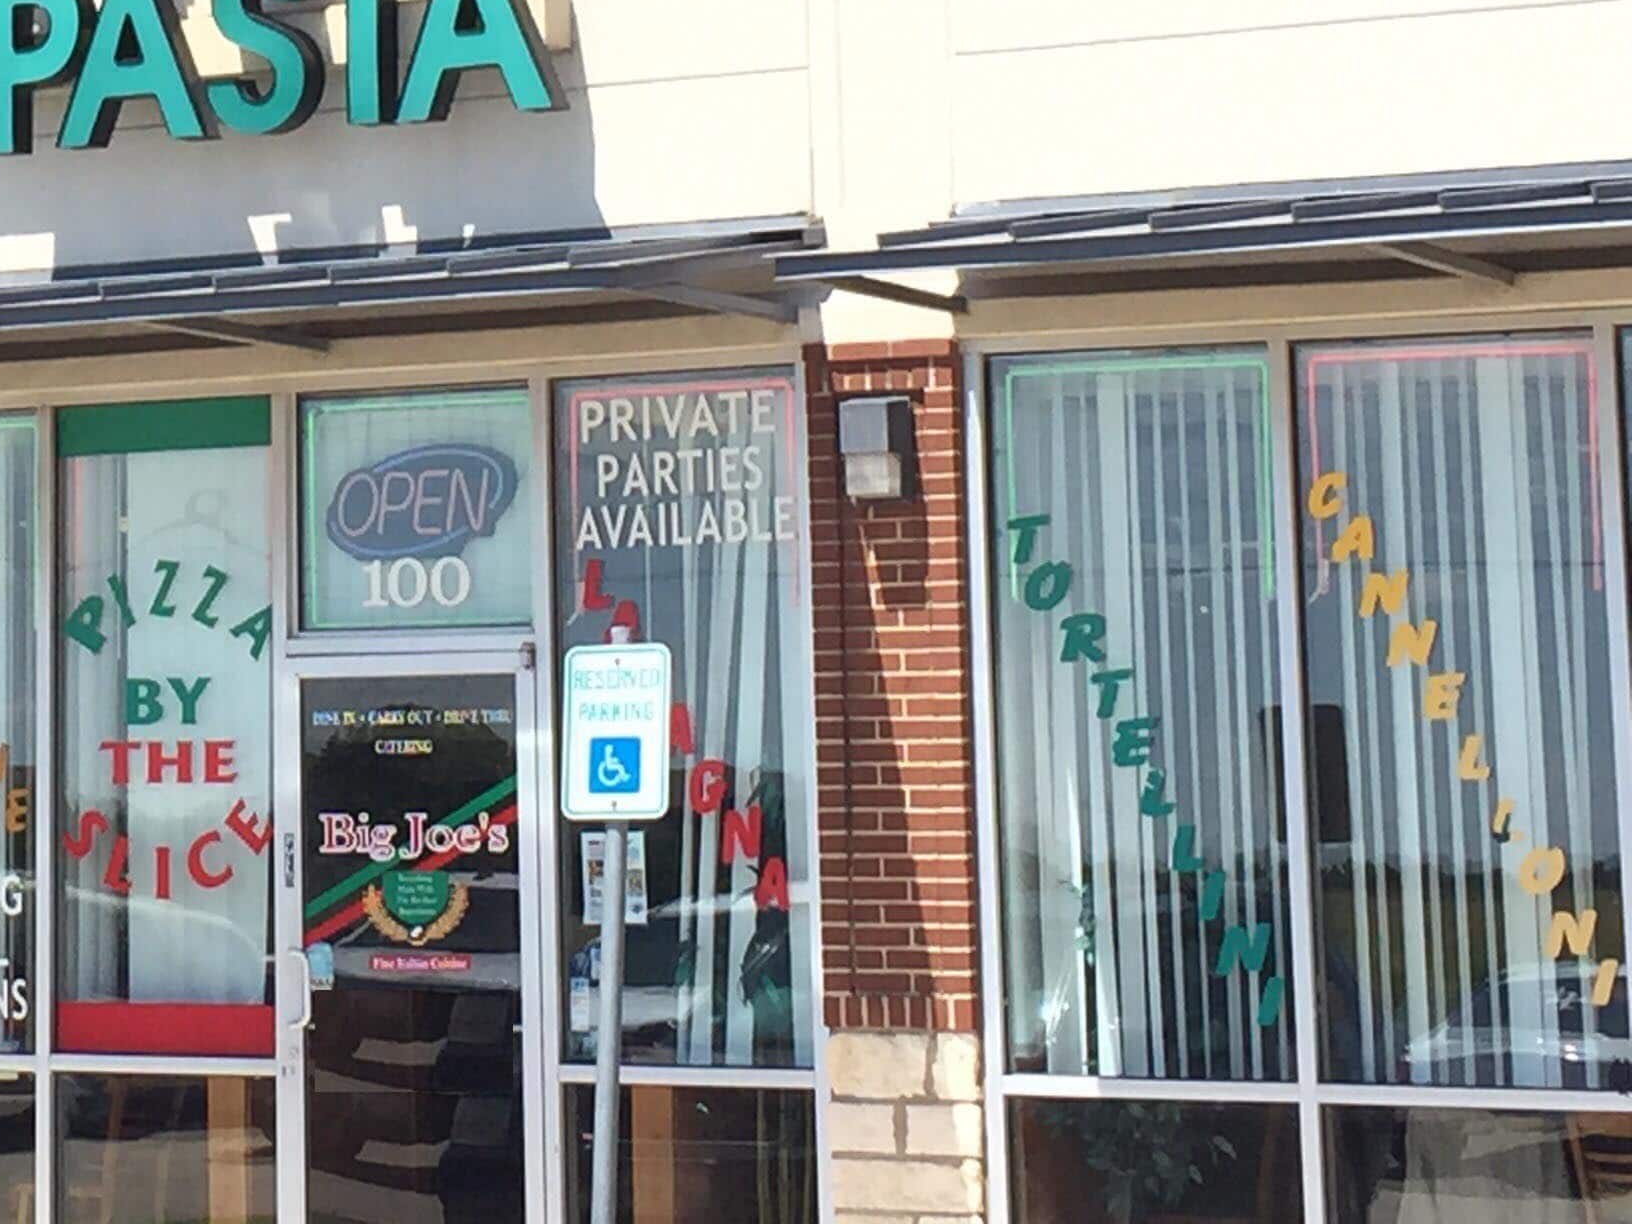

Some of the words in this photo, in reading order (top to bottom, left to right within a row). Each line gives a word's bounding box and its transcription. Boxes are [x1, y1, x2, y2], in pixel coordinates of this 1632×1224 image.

[579, 390, 778, 443] PRIVATE
[597, 447, 765, 498] PARTIES
[336, 467, 491, 538] OPEN
[576, 497, 798, 550] AVAILABLE
[361, 557, 471, 608] 100
[65, 560, 273, 660] PIZZA
[126, 677, 211, 724] BY
[574, 668, 661, 689] RESERVED
[579, 702, 655, 721] PARKING
[582, 558, 790, 912] LAAGNA
[99, 739, 238, 784] THE
[1008, 514, 1282, 1026] TORTELLINI
[63, 798, 274, 900] SLICE
[318, 812, 398, 861] Big
[398, 812, 509, 860] Joe's
